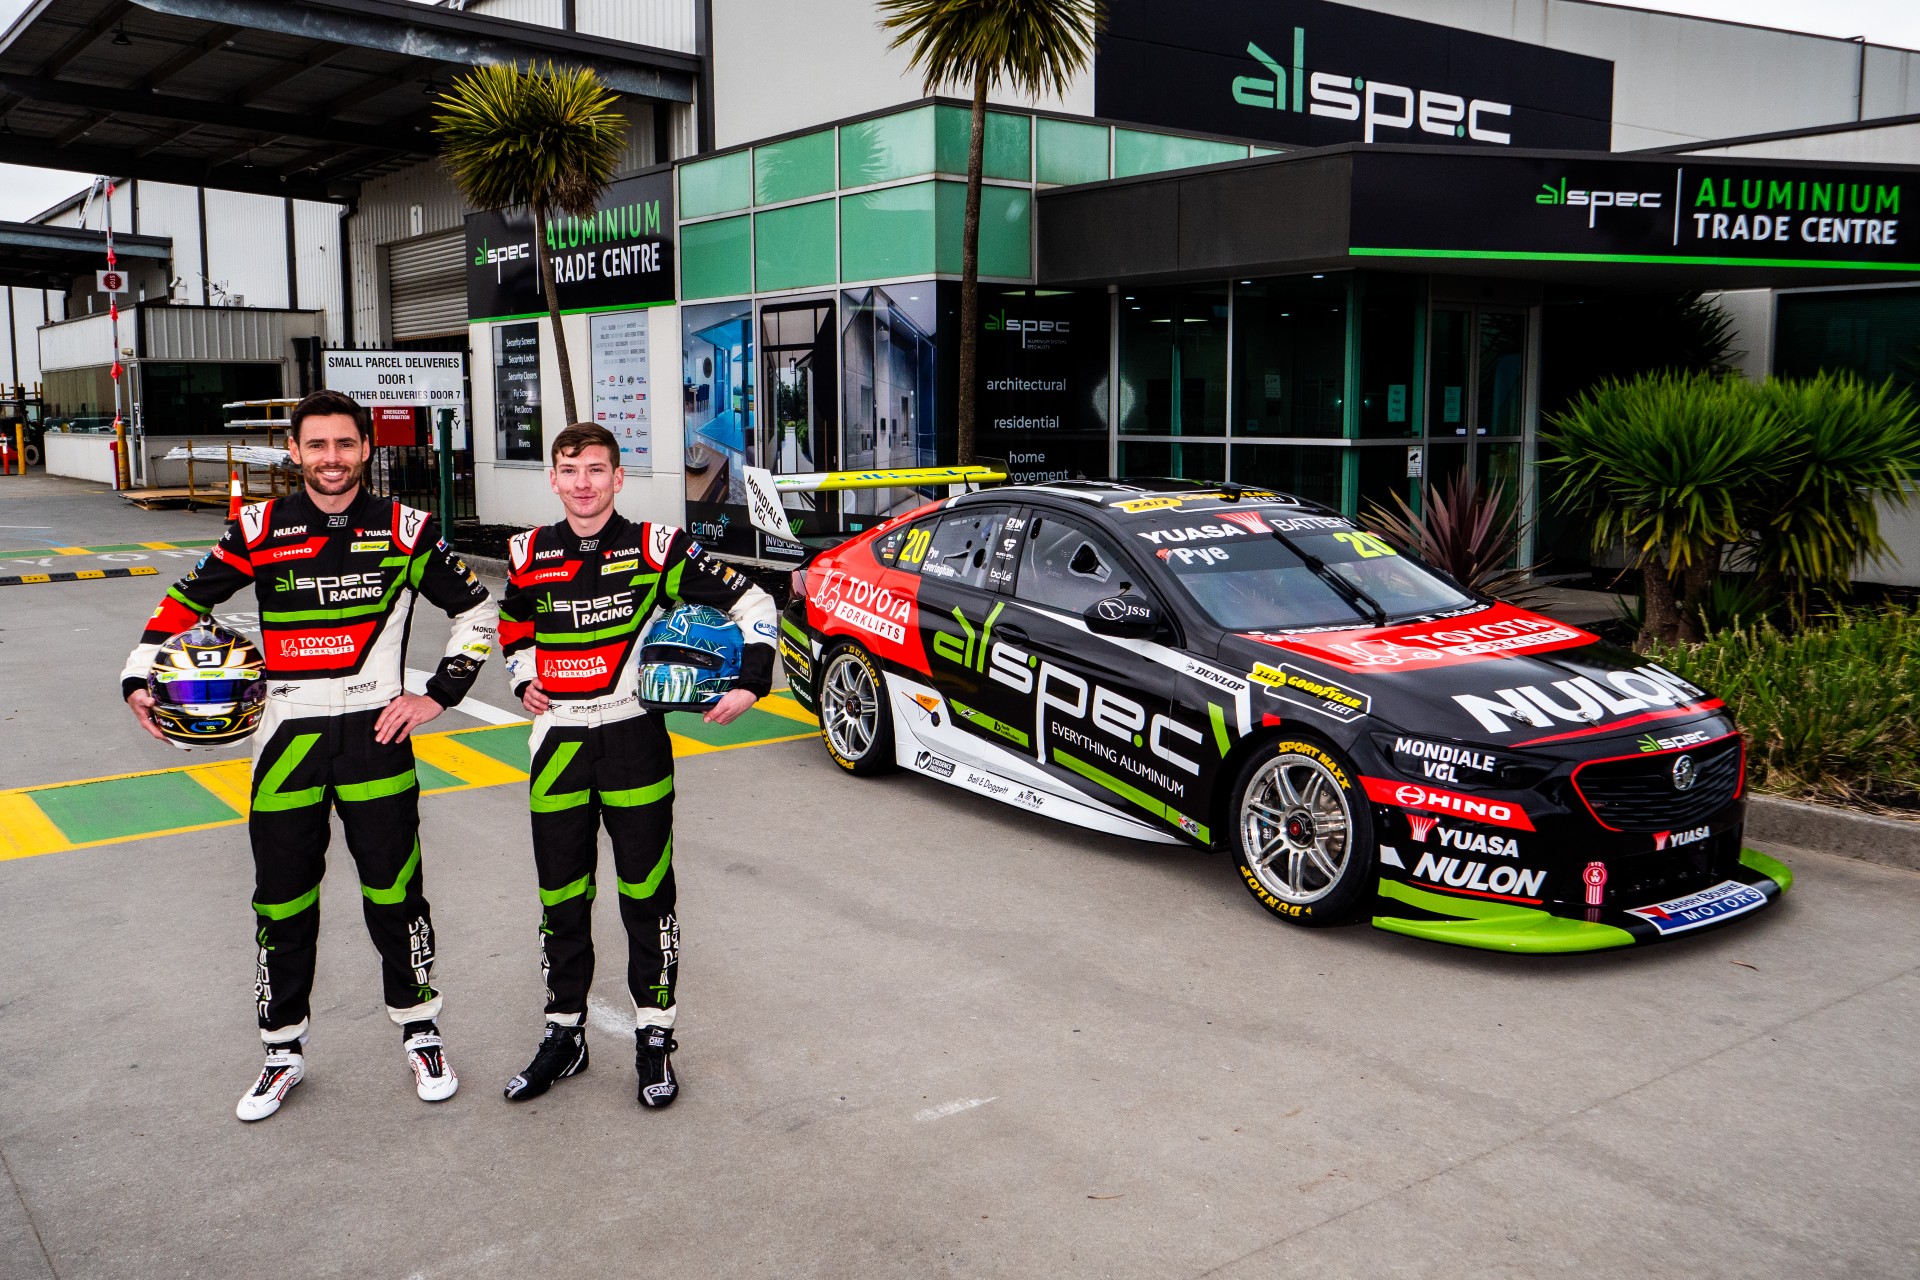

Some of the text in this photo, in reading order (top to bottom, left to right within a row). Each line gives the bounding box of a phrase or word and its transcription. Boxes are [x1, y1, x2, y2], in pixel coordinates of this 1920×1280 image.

[1231, 27, 1512, 145] alspec
[1535, 177, 1662, 229] alspec
[1694, 177, 1900, 214] ALUMINIUM
[546, 200, 661, 250] ALUMINIUM
[1693, 213, 1899, 245] TRADE CENTRE
[474, 238, 530, 285] alspec
[550, 242, 661, 284] RADE CENTRE
[984, 308, 1070, 349] alspec
[506, 338, 521, 348] Security
[328, 357, 460, 369] SMALL PARCEL DELIVERIES
[508, 354, 535, 365] Security Locks
[378, 374, 414, 385] DOOR 1
[508, 372, 523, 382] Security
[986, 377, 1067, 391] architectural
[349, 390, 461, 400] OTHER DELIVERIES DOOR 7
[517, 422, 531, 431] Screws
[994, 416, 1060, 428] residential
[518, 439, 531, 448] Rivets
[1009, 451, 1046, 463] home
[1011, 469, 1069, 481] rovement
[747, 474, 783, 530] MONDIALE
[327, 515, 348, 528] 20
[754, 503, 768, 527] VGL
[273, 525, 307, 538] NULON
[365, 529, 393, 537] YUASA
[691, 521, 724, 540] carinya
[1137, 523, 1240, 544] YUASA
[283, 547, 313, 556] HINO
[535, 549, 564, 560] NULON
[580, 540, 600, 552] 20
[613, 547, 640, 558] YUASA
[898, 528, 931, 564] 20
[928, 546, 939, 559] Pye
[1333, 530, 1398, 559] 20
[1171, 546, 1230, 566] Pye
[922, 560, 955, 578] Everingham
[274, 569, 383, 605] alspec
[329, 586, 383, 602] RACING
[536, 591, 633, 629] alspec
[845, 576, 911, 624] TOYOTA
[581, 605, 634, 626] RACING
[840, 602, 901, 641] FORKLIFTS
[1126, 605, 1151, 618] JSSI
[298, 634, 354, 648] TOYOTA
[1401, 618, 1550, 647] TOYOTA
[302, 646, 353, 655] FORKLIFTS
[555, 655, 606, 670] TOYOTA
[561, 667, 605, 677] FORKLIFTS
[847, 645, 880, 688] DUNLOP
[933, 601, 1204, 777] alspec
[1195, 666, 1246, 691] DUNLOP
[1287, 675, 1363, 709] GOODYEAR
[1452, 663, 1706, 734] NULON
[1321, 700, 1356, 716] FLEET
[1637, 730, 1712, 753] alspec
[1052, 721, 1117, 763] EVERYTHING
[1119, 751, 1185, 798] ALUMINIUM
[1278, 741, 1352, 790] SPORT MAXX
[1395, 737, 1497, 772] MONDIALE
[1423, 760, 1459, 783] VGL
[967, 773, 980, 784] Ball
[983, 779, 1009, 794] Doggett
[1427, 793, 1512, 821] HINO
[1437, 826, 1520, 858] YUASA
[1669, 825, 1711, 848] YUASA
[1412, 852, 1548, 897] NULON
[1240, 866, 1303, 917] DUNLOP
[1662, 882, 1743, 912] BARRY BOURKE
[1681, 888, 1761, 921] MOTORS
[649, 1036, 664, 1047] OMP
